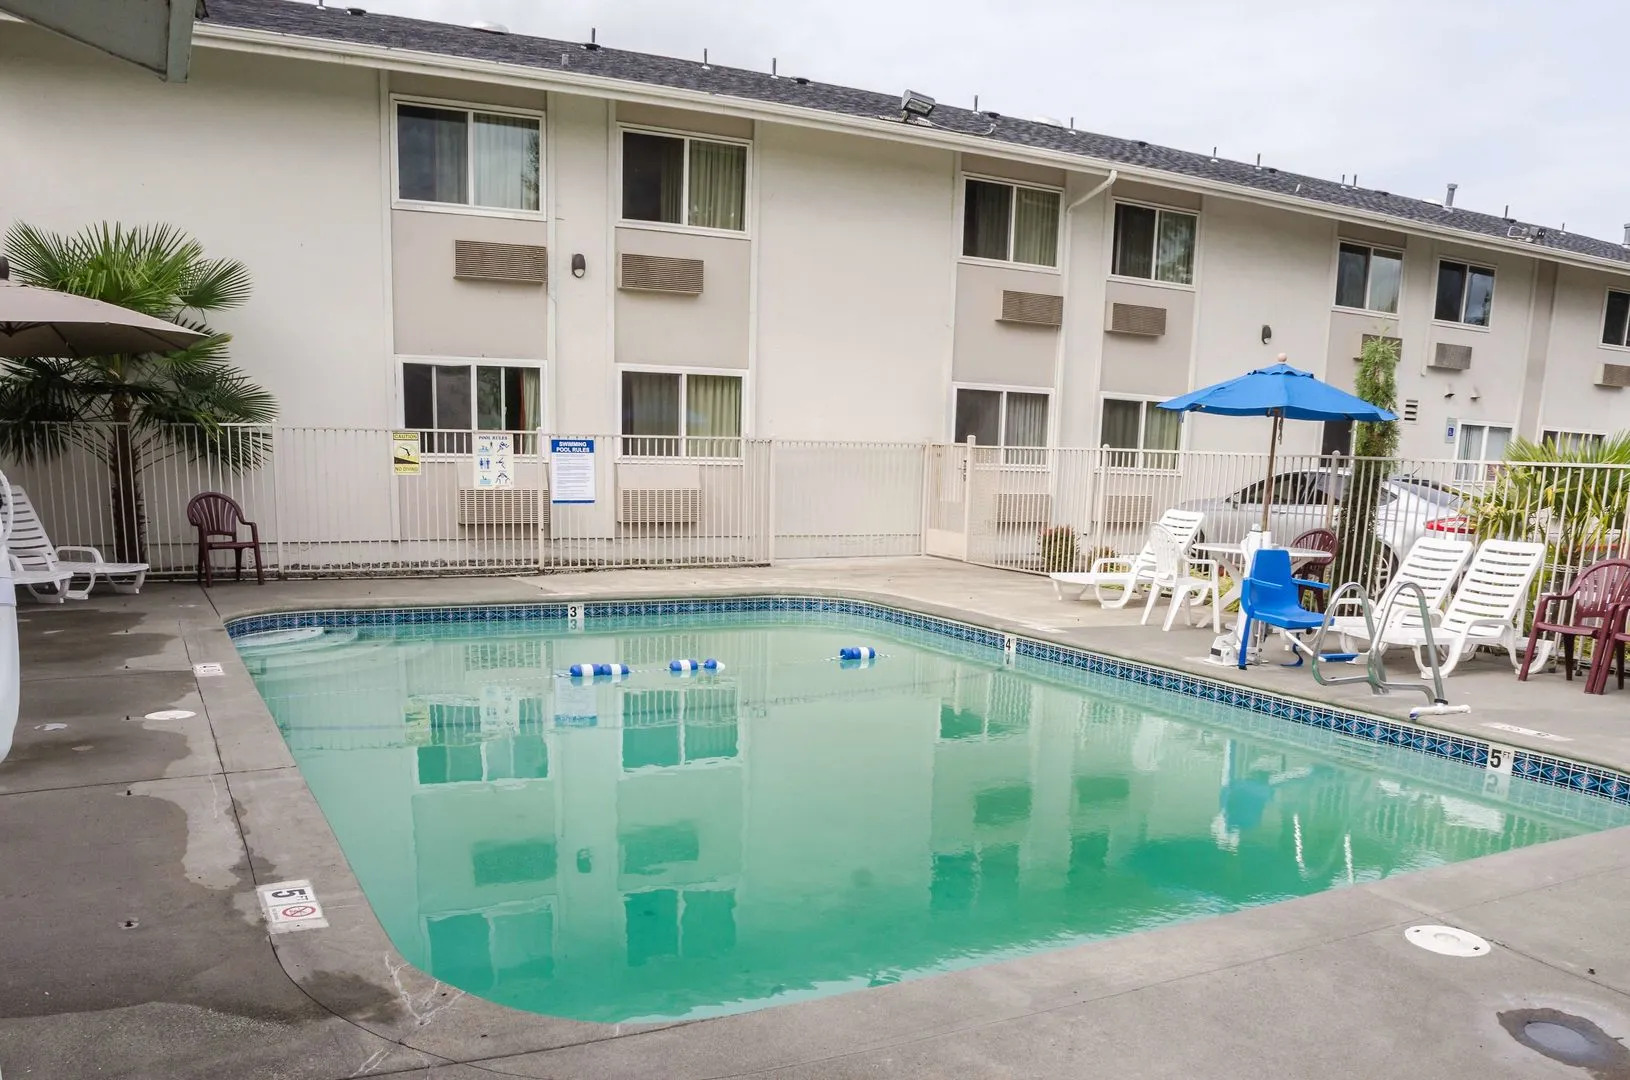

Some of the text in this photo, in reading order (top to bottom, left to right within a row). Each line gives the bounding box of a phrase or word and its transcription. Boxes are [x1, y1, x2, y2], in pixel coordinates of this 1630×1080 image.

[570, 606, 577, 618] 3
[1005, 637, 1011, 651] 4
[1490, 748, 1511, 768] 5 FT
[271, 888, 306, 899] 5
